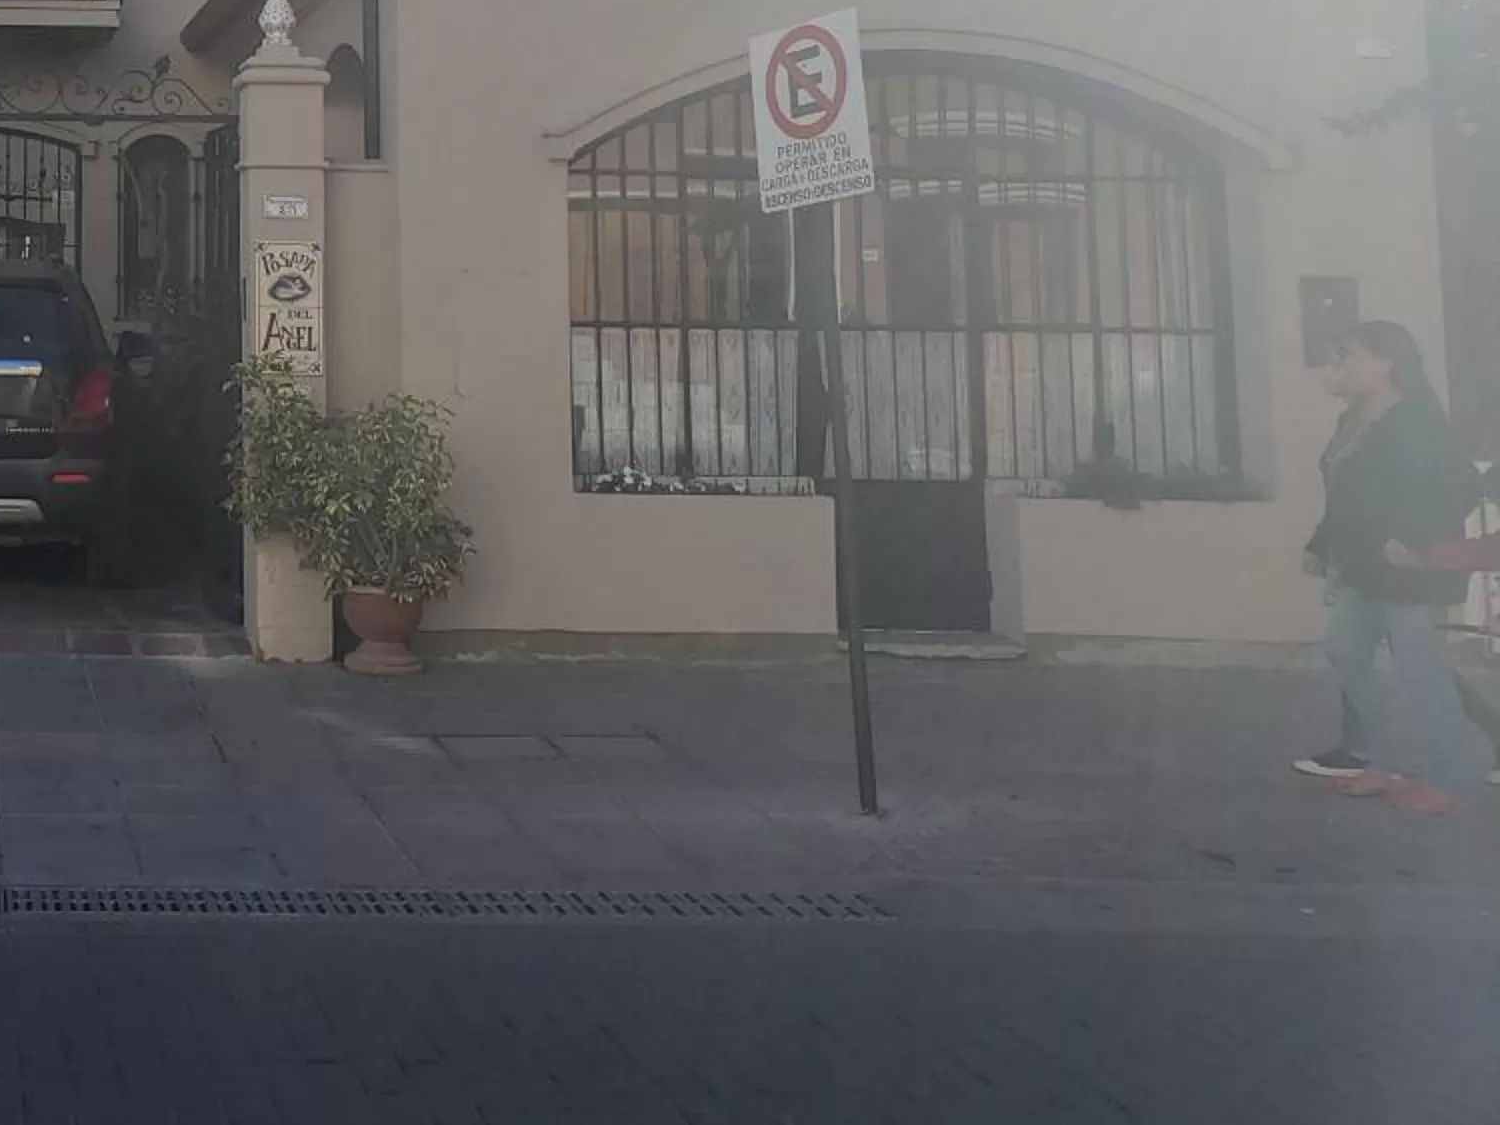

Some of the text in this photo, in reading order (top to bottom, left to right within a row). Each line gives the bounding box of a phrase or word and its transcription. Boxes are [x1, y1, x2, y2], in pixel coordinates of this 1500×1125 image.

[777, 131, 847, 159] PERMITIDO
[775, 146, 851, 173] OPERAR EN
[761, 171, 799, 192] CARGA
[807, 158, 869, 181] DESCARGA
